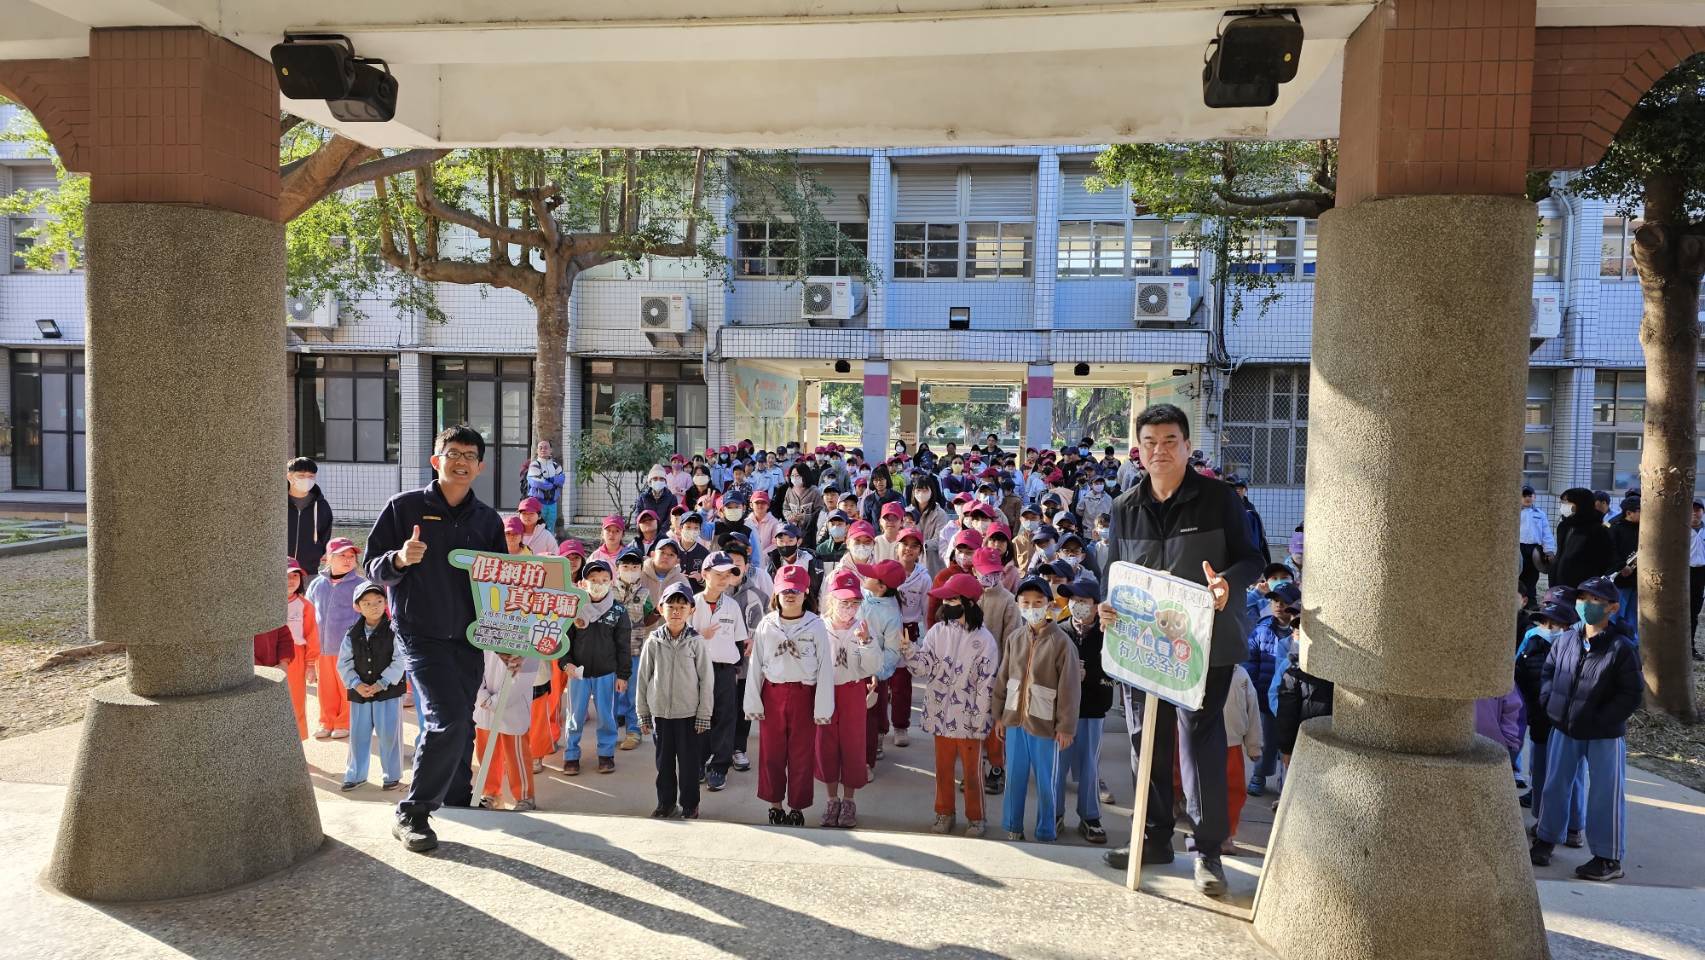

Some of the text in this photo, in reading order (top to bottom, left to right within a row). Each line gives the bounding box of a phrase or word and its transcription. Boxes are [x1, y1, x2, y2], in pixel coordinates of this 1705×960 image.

[473, 555, 545, 587] 假網拍
[505, 586, 578, 617] 真詐騙
[1119, 640, 1189, 679] 行人安全行
